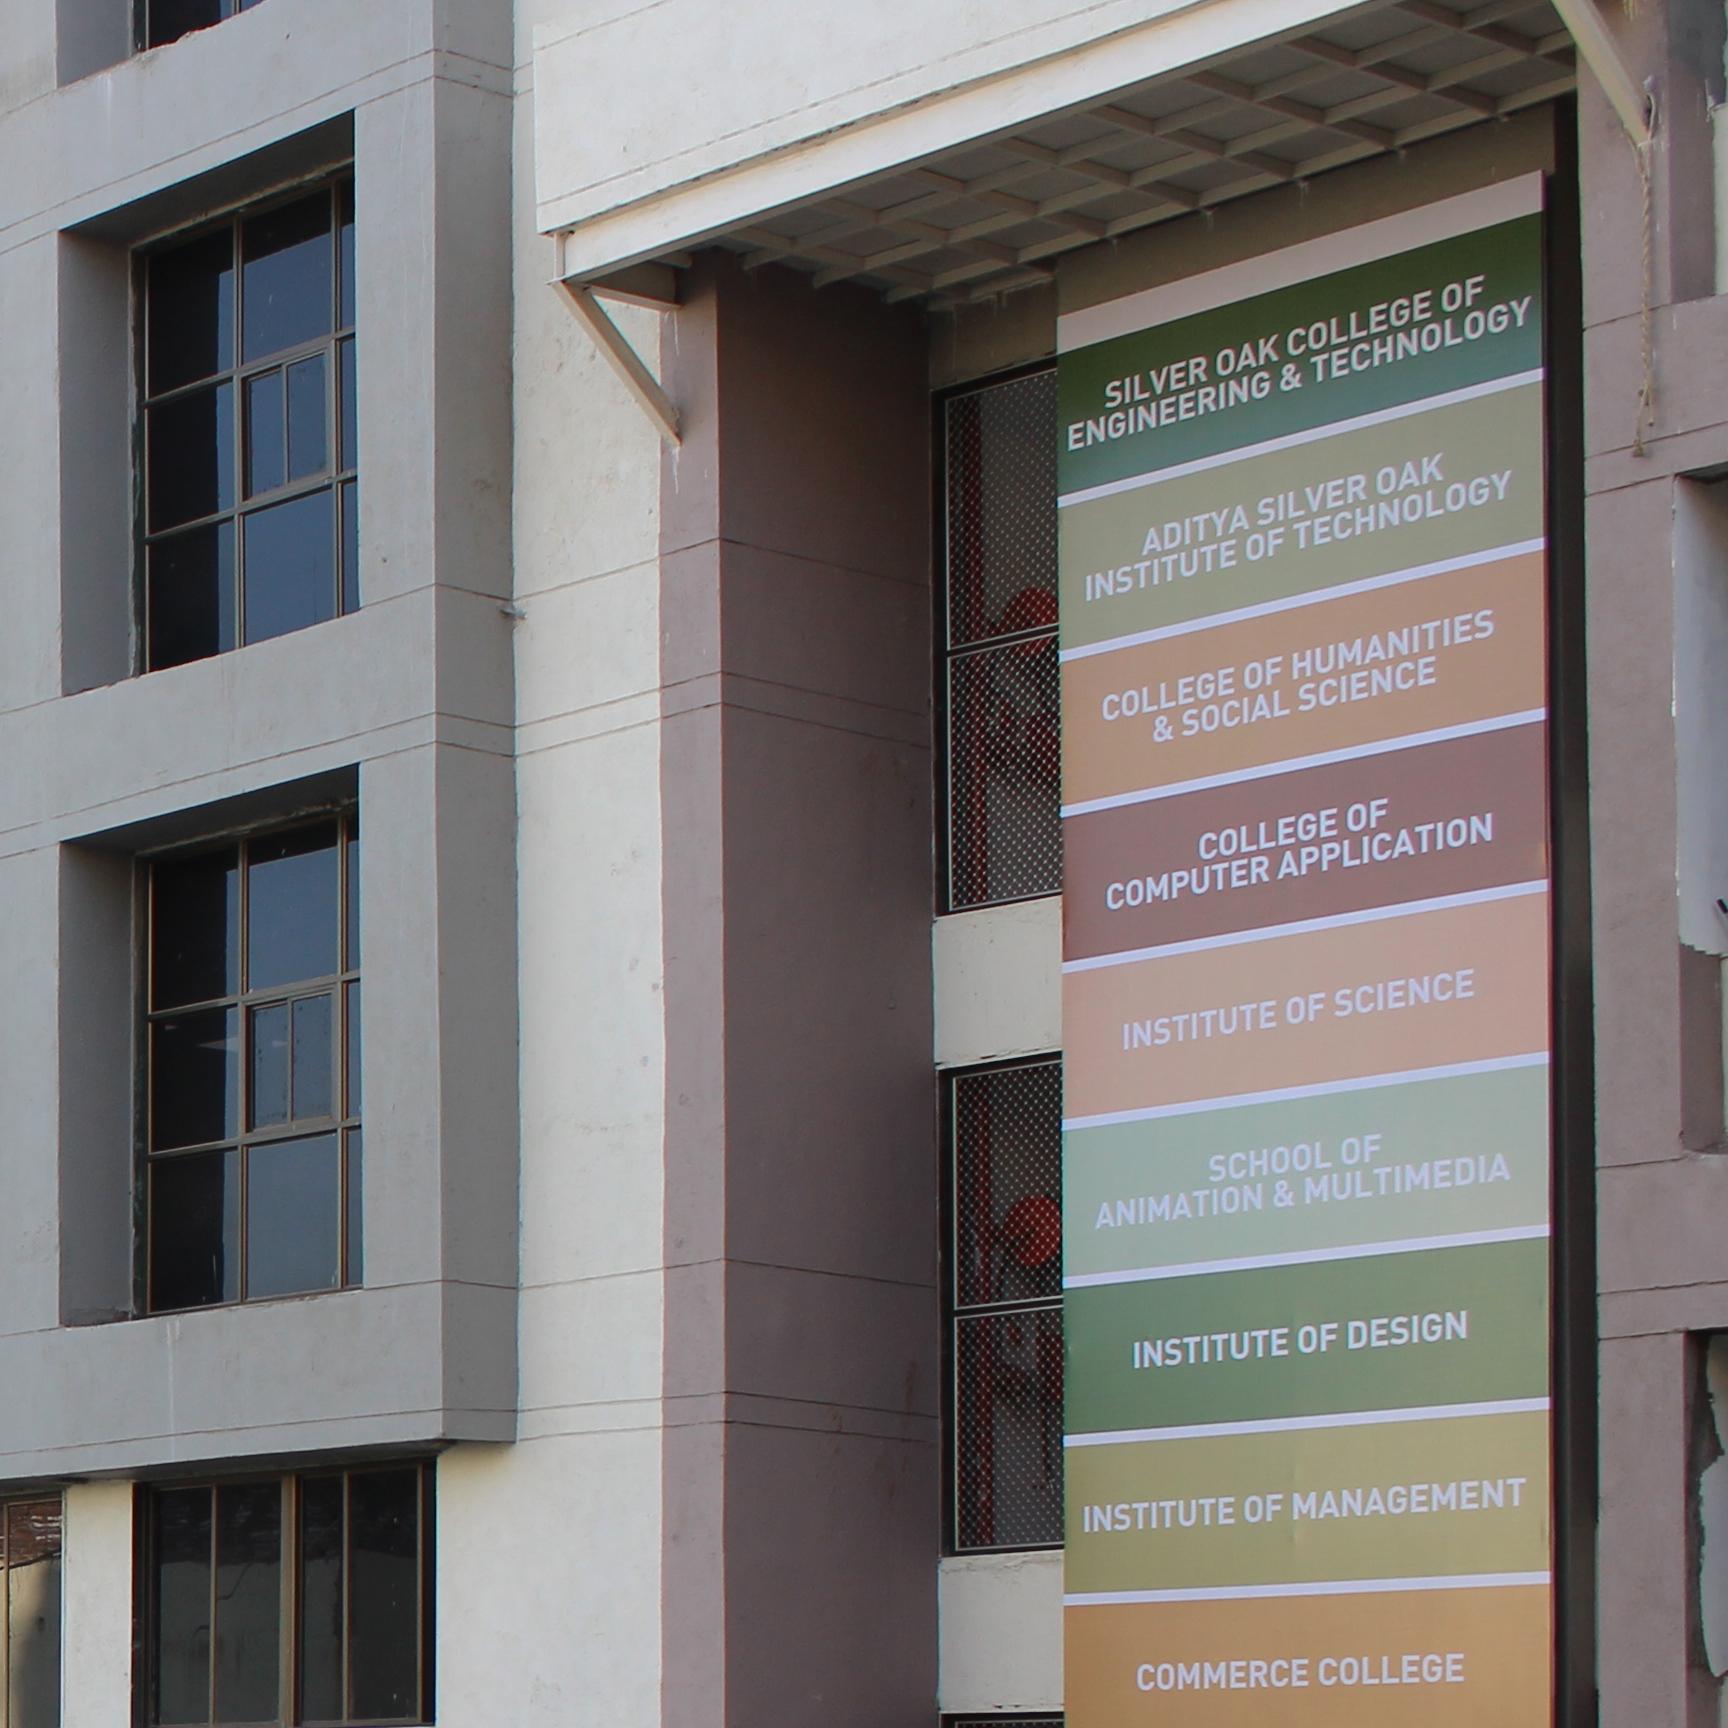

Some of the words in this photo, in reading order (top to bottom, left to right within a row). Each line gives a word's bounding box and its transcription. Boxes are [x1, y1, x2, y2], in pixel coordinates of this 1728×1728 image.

[1066, 374, 1272, 451] ENGINEERING
[1280, 362, 1302, 391] &
[1310, 296, 1532, 382] TECHNOLOGY
[1103, 357, 1207, 409] SILVER
[1215, 334, 1280, 378] OAK
[1286, 298, 1433, 356] COLLEGE
[1441, 275, 1484, 311] OF
[1085, 539, 1238, 601] INSTITUTE
[1245, 530, 1285, 561] OF
[1292, 471, 1512, 549] TECHNOLOGY
[1141, 504, 1250, 556] ADITYA
[1256, 472, 1368, 528] SILVER
[1376, 453, 1445, 497] OAK
[1101, 666, 1236, 721] COLLEGE
[1243, 656, 1283, 689] OF
[1290, 610, 1495, 679] HUMANITIES
[1152, 714, 1175, 743] &
[1181, 692, 1291, 737] SOCIAL
[1298, 656, 1436, 711] SCIENCE
[1105, 856, 1270, 911] COMPUTER
[1276, 812, 1493, 880] APPLICATION
[1198, 808, 1339, 860] COLLEGE
[1346, 798, 1388, 832] OF
[1122, 1001, 1277, 1049] INSTITUTE
[1285, 994, 1325, 1024] OF
[1333, 969, 1475, 1018] SCIENCE
[1095, 1182, 1265, 1229] ANIMATION
[1272, 1178, 1295, 1208] &
[1303, 1152, 1511, 1204] MULTIMEDIA
[1208, 1141, 1333, 1182] SCHOOL
[1340, 1134, 1383, 1165] OF
[1132, 1328, 1290, 1369] INSTITUTE
[1297, 1322, 1338, 1354] OF
[1346, 1310, 1468, 1351] DESIGN
[1082, 1498, 1236, 1533] INSTITUTE
[1244, 1493, 1284, 1523] OF
[1291, 1478, 1527, 1521] MANAGEMENT
[1136, 1658, 1310, 1692] COMMERCE
[1316, 1652, 1465, 1686] COLLEGE
